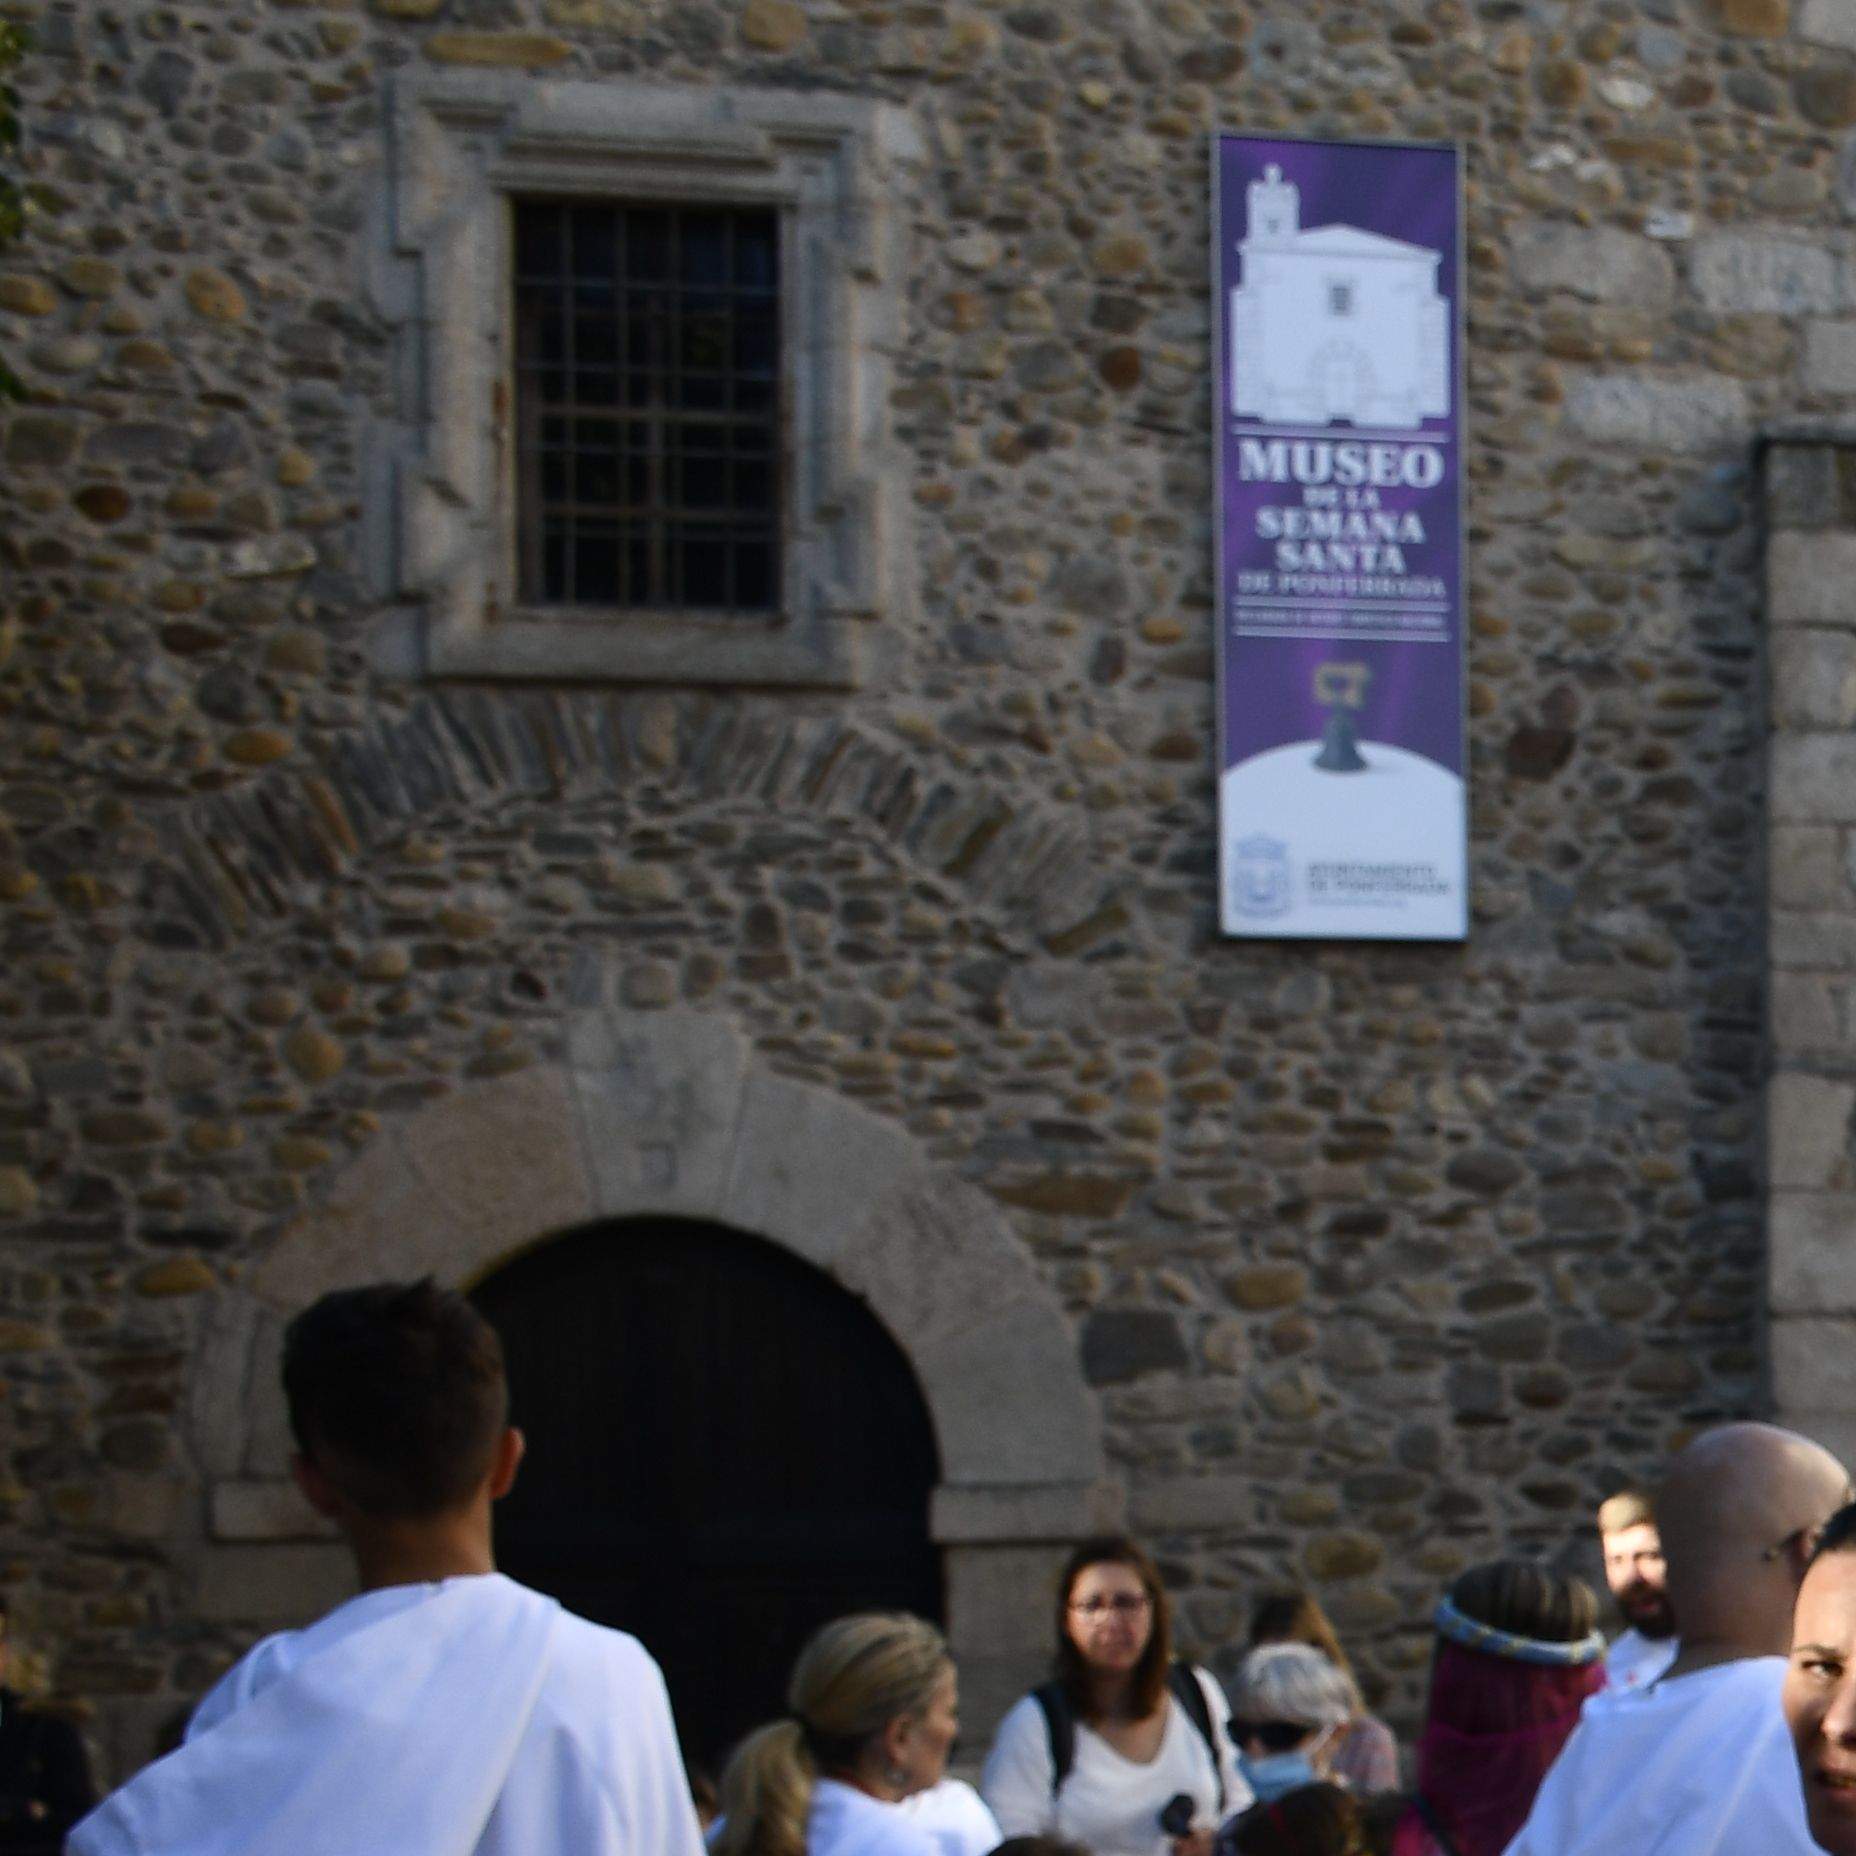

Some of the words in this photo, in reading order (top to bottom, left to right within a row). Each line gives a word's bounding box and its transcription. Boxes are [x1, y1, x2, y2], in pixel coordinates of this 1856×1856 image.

[1237, 439, 1445, 488] MUSEO
[1256, 507, 1426, 543] SEMANA
[1277, 542, 1405, 573] SANTA
